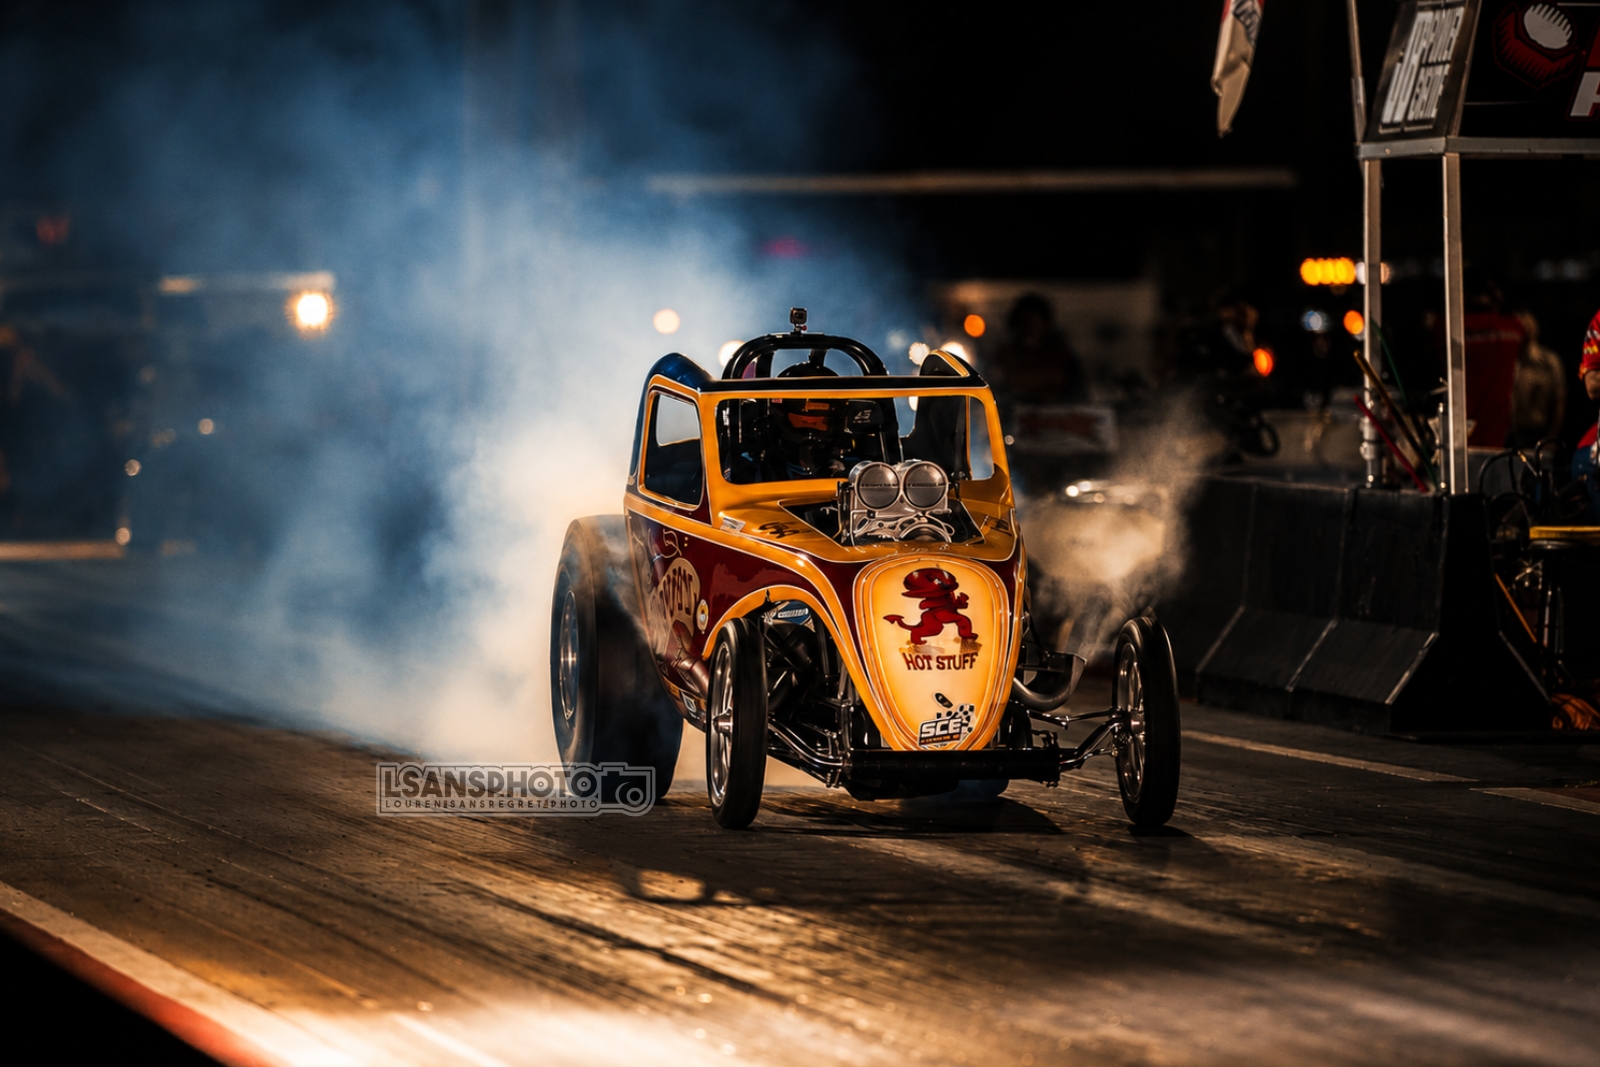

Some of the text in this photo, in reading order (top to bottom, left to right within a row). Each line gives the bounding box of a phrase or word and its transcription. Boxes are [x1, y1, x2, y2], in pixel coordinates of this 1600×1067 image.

[902, 651, 979, 671] HOT STUFF
[920, 718, 962, 738] SCE
